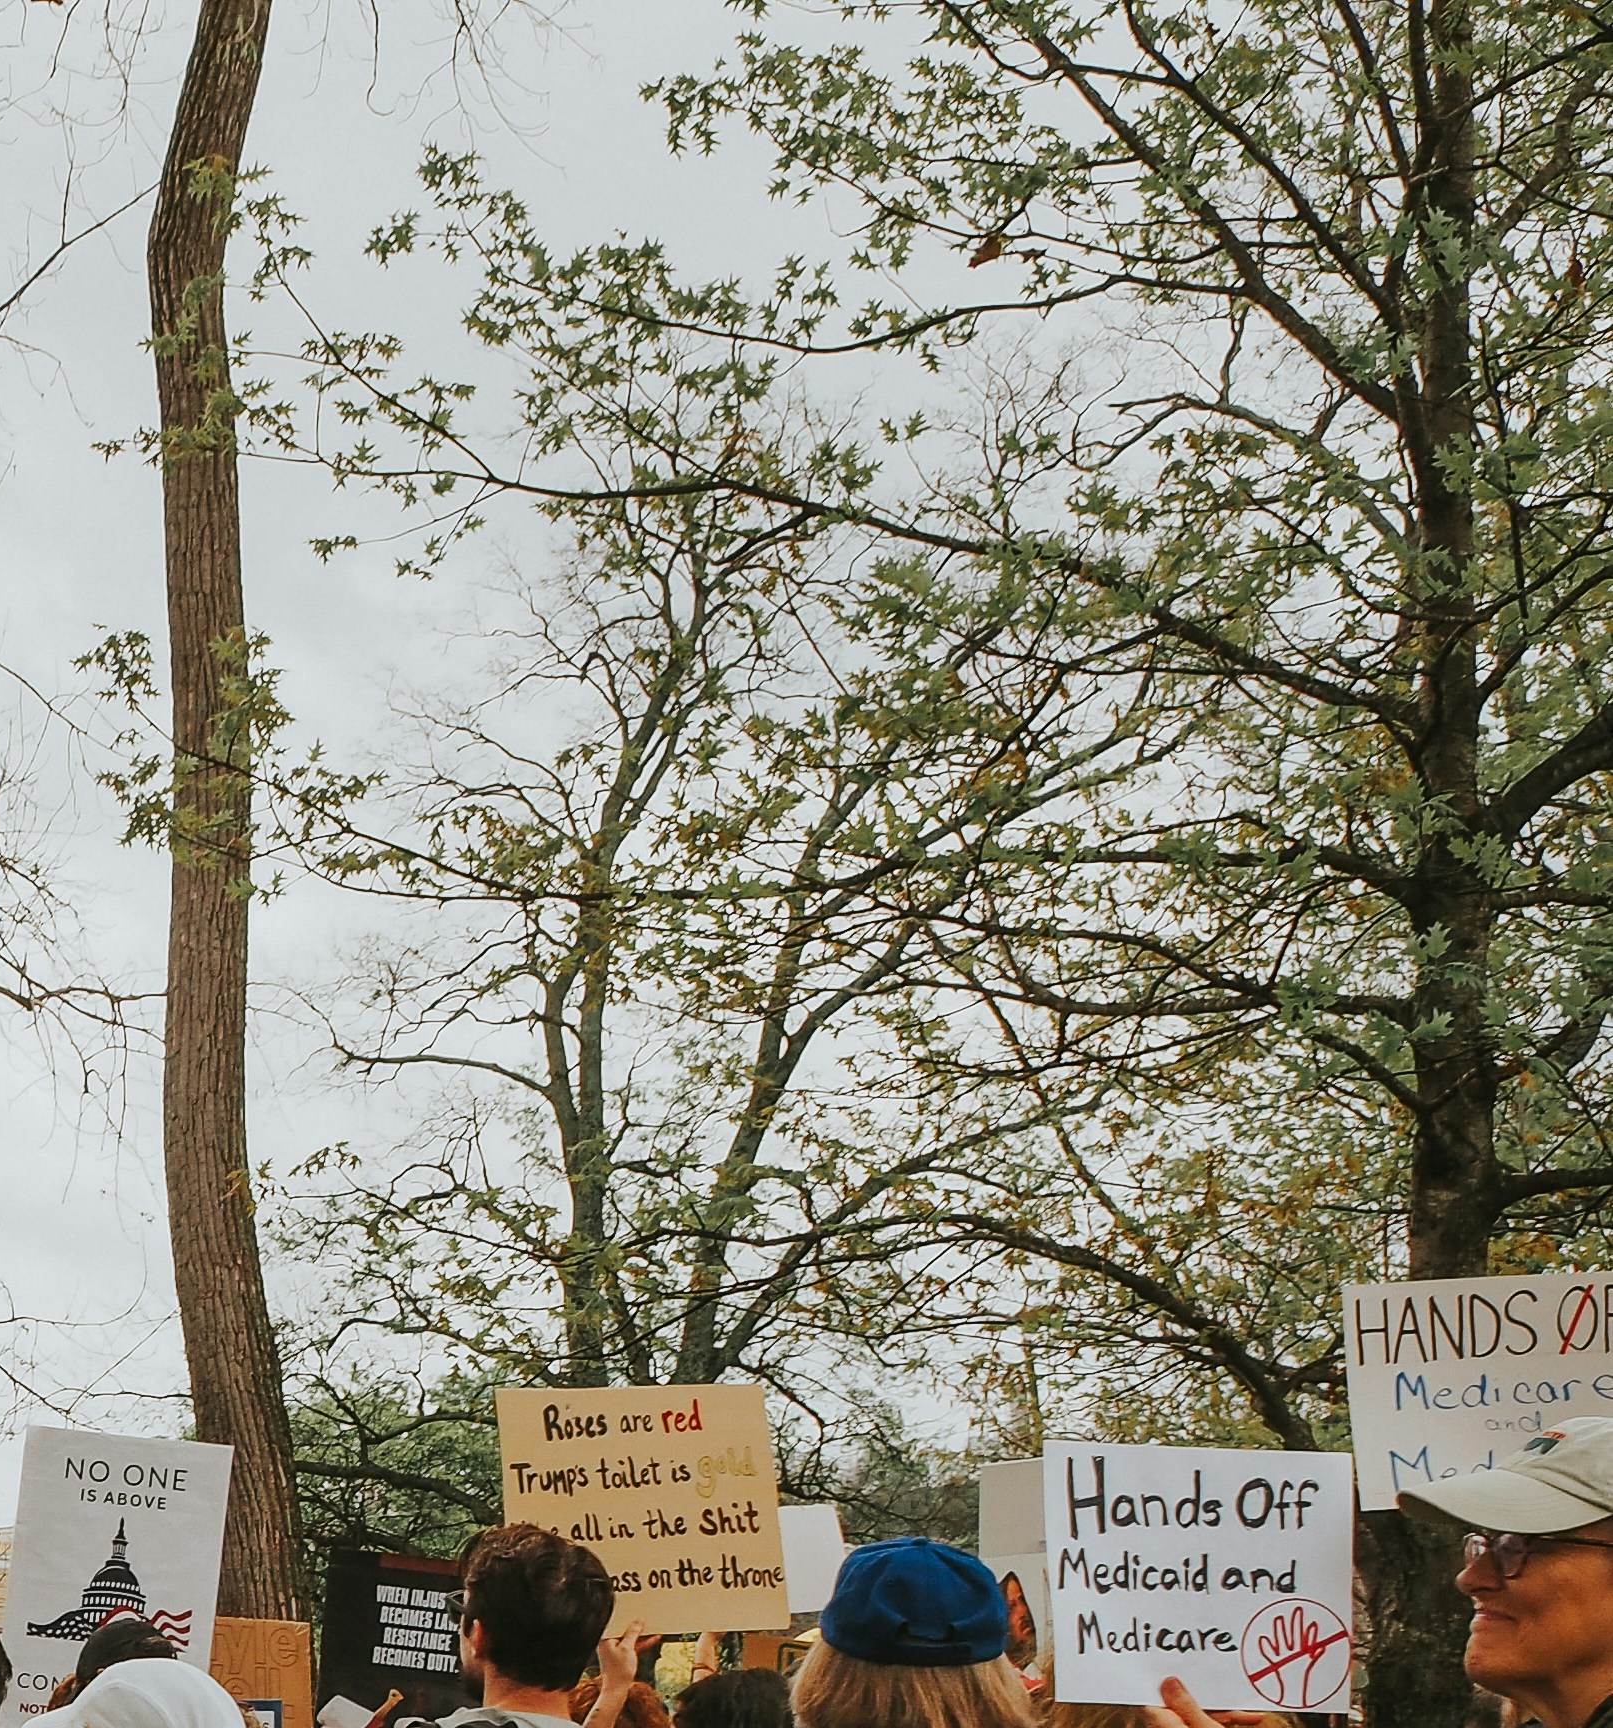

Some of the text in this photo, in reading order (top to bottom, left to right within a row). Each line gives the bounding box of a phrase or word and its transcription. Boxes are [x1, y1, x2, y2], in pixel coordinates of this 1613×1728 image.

[1355, 1289, 1538, 1366] HANDS
[1396, 1371, 1613, 1411] Medicare
[543, 1399, 703, 1441] Roses are red
[1485, 1411, 1542, 1433] and
[65, 1457, 188, 1491] NO ONE
[596, 1456, 662, 1490] toilet
[670, 1459, 691, 1484] is
[696, 1447, 757, 1498] gold
[80, 1488, 167, 1510] IS ABOVE
[1066, 1455, 1319, 1540] Hands Off
[570, 1513, 603, 1541] all
[609, 1517, 635, 1539] in
[643, 1509, 687, 1539] the
[648, 1569, 672, 1589] on
[674, 1558, 714, 1587] the
[717, 1553, 784, 1589] throne
[1058, 1547, 1296, 1595] Medicaid and
[376, 1584, 409, 1605] WHEN
[380, 1606, 433, 1629] BECOMES
[1078, 1610, 1238, 1654] Medicare
[383, 1626, 452, 1651] RESISTANCE
[372, 1646, 460, 1673] BECOMES DUTY.
